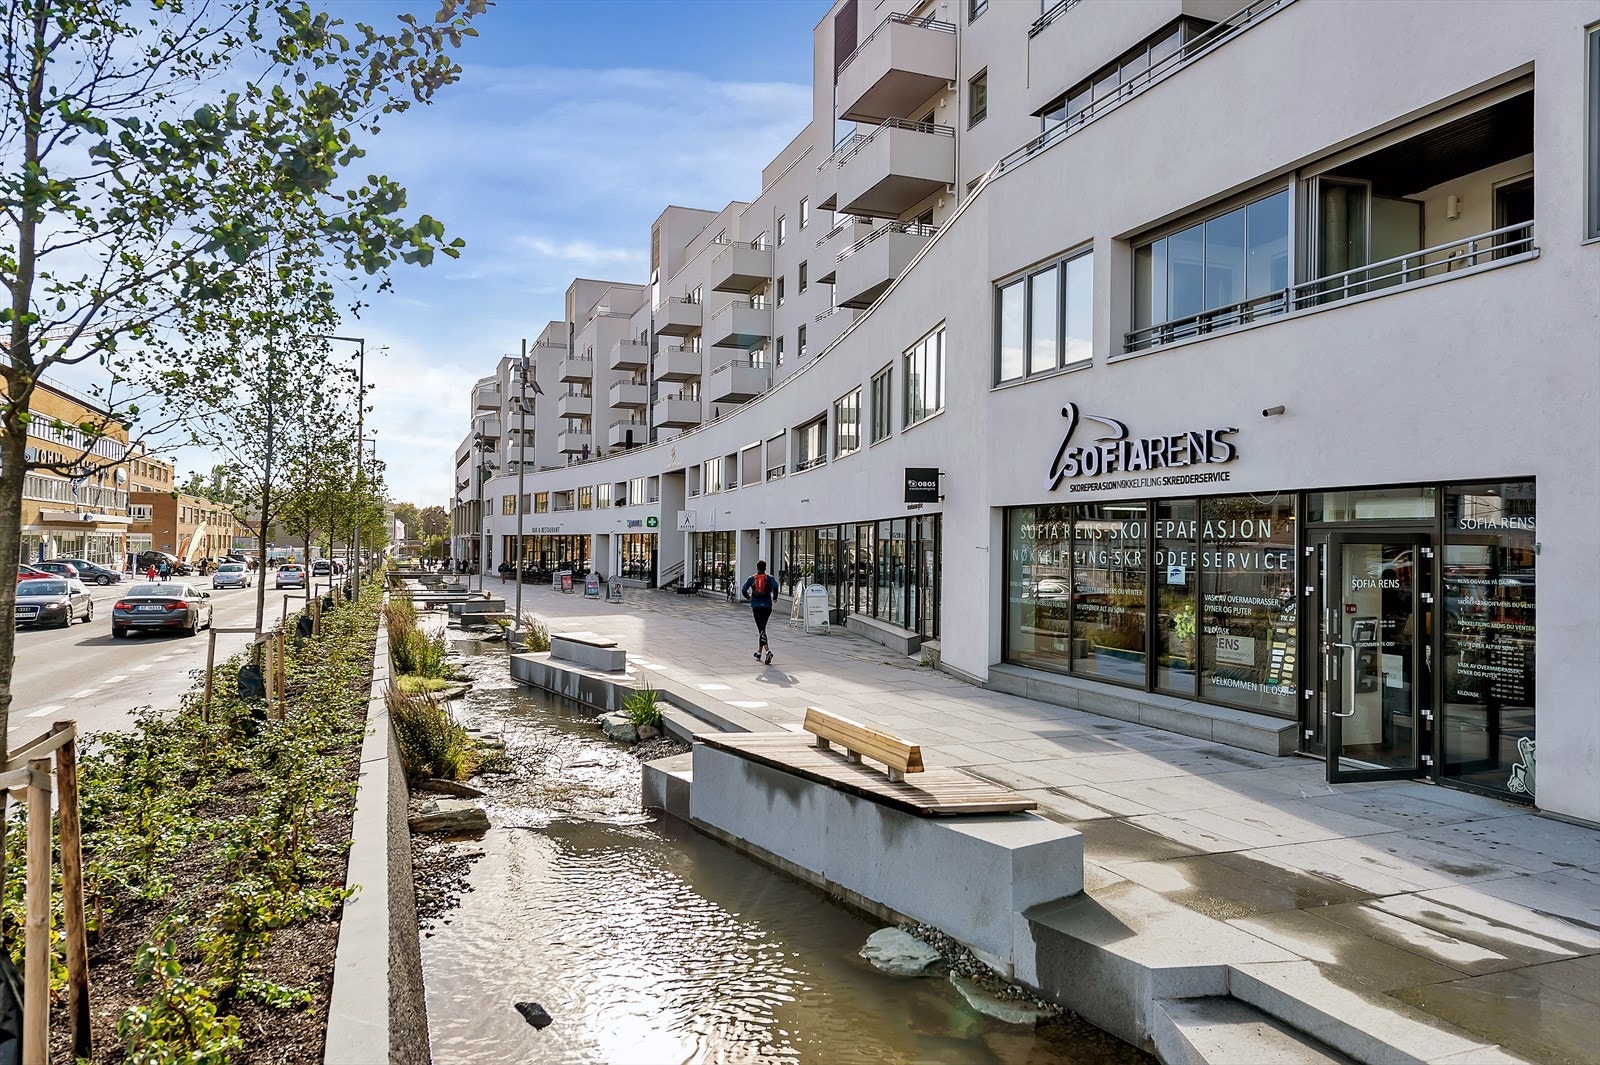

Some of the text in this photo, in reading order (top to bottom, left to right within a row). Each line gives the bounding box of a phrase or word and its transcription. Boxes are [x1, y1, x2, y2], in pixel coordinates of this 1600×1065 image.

[1162, 471, 1231, 486] SKREDDERSERVICE
[1460, 516, 1536, 530] SOFIA RENS
[1020, 523, 1060, 540] SOFIA
[1351, 579, 1400, 589] SOFIA RENS
[1219, 594, 1227, 602] AV
[1204, 604, 1252, 616] DYNER OG PUTER
[1211, 675, 1257, 691] VELKOMMEN
[1259, 683, 1270, 694] TIL
[1457, 690, 1480, 698] KILOVASK
